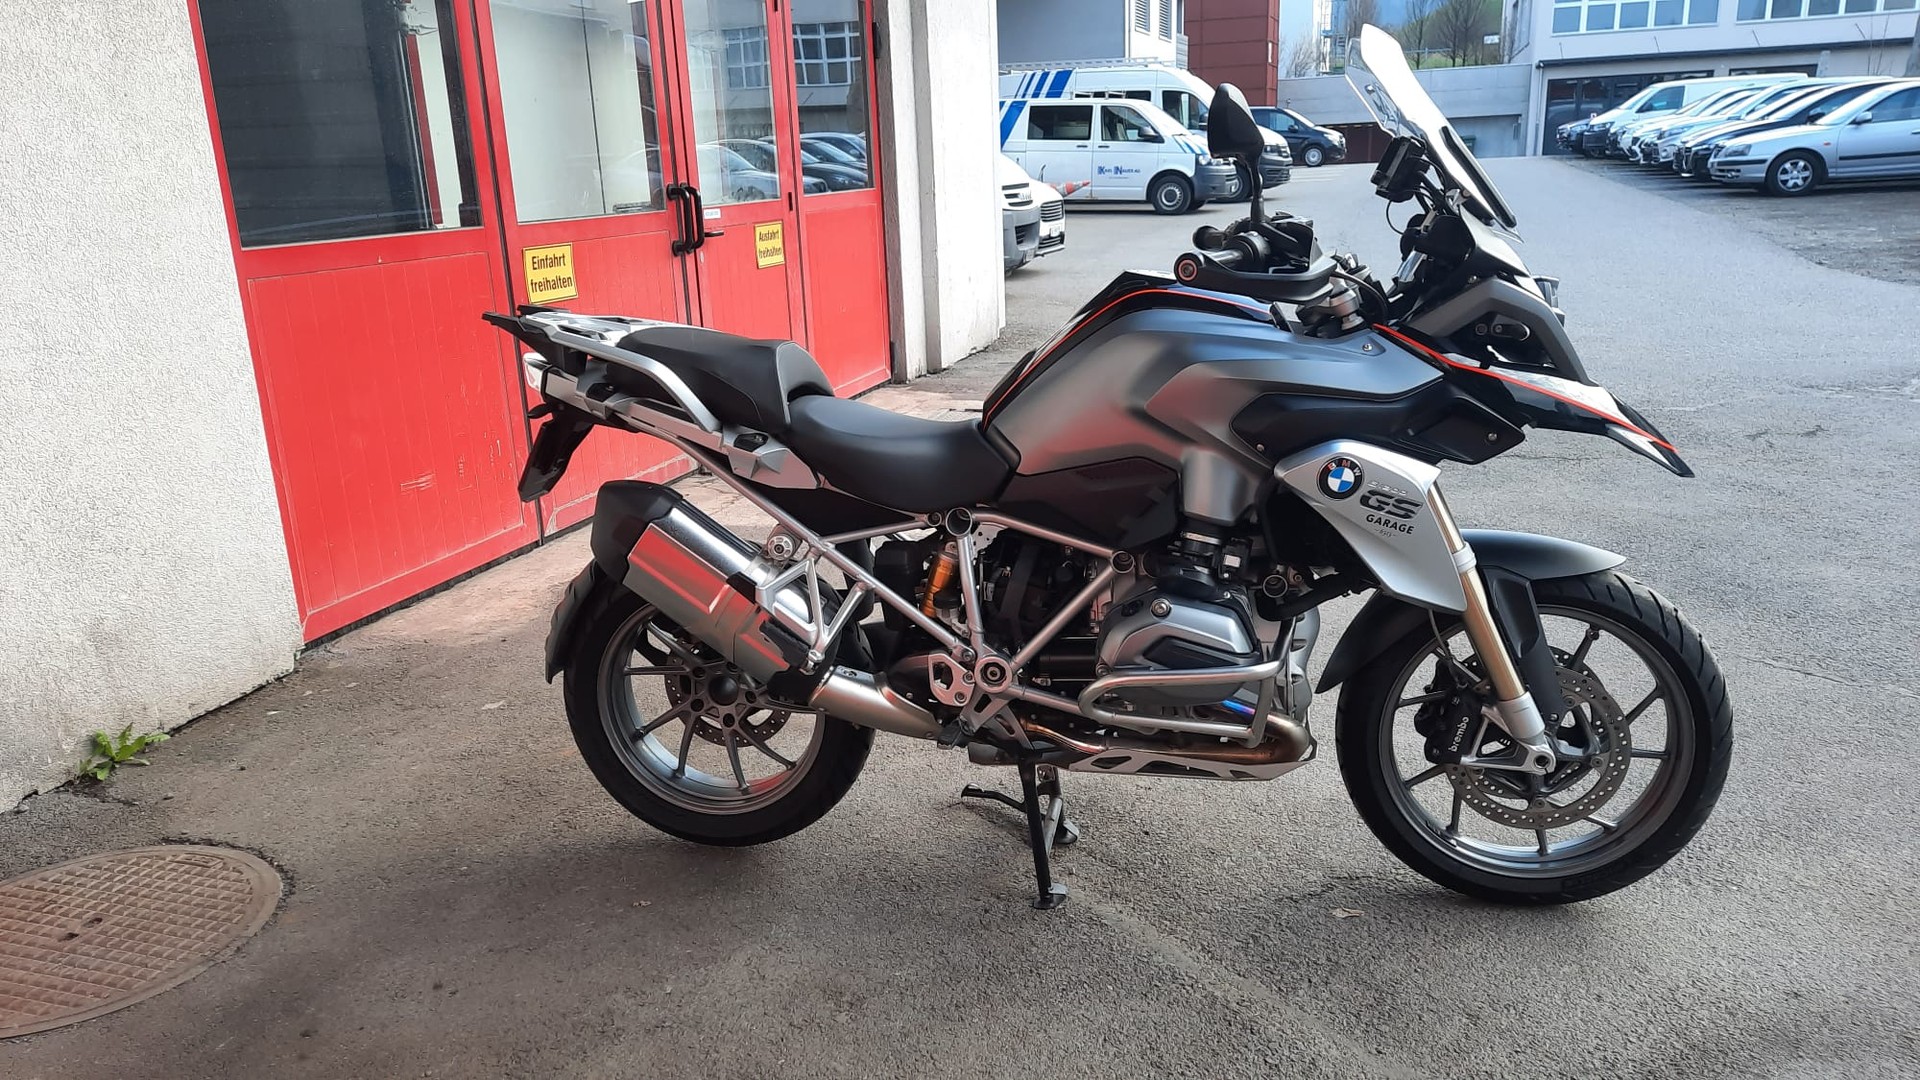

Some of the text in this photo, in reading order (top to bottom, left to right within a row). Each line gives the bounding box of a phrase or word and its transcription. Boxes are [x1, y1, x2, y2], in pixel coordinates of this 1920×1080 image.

[531, 253, 566, 270] Einfahrt
[530, 275, 573, 293] freihalten
[1327, 459, 1362, 477] BMW
[1360, 489, 1424, 520] GS
[1366, 514, 1415, 535] GARAGE
[1447, 716, 1470, 752] brembo
